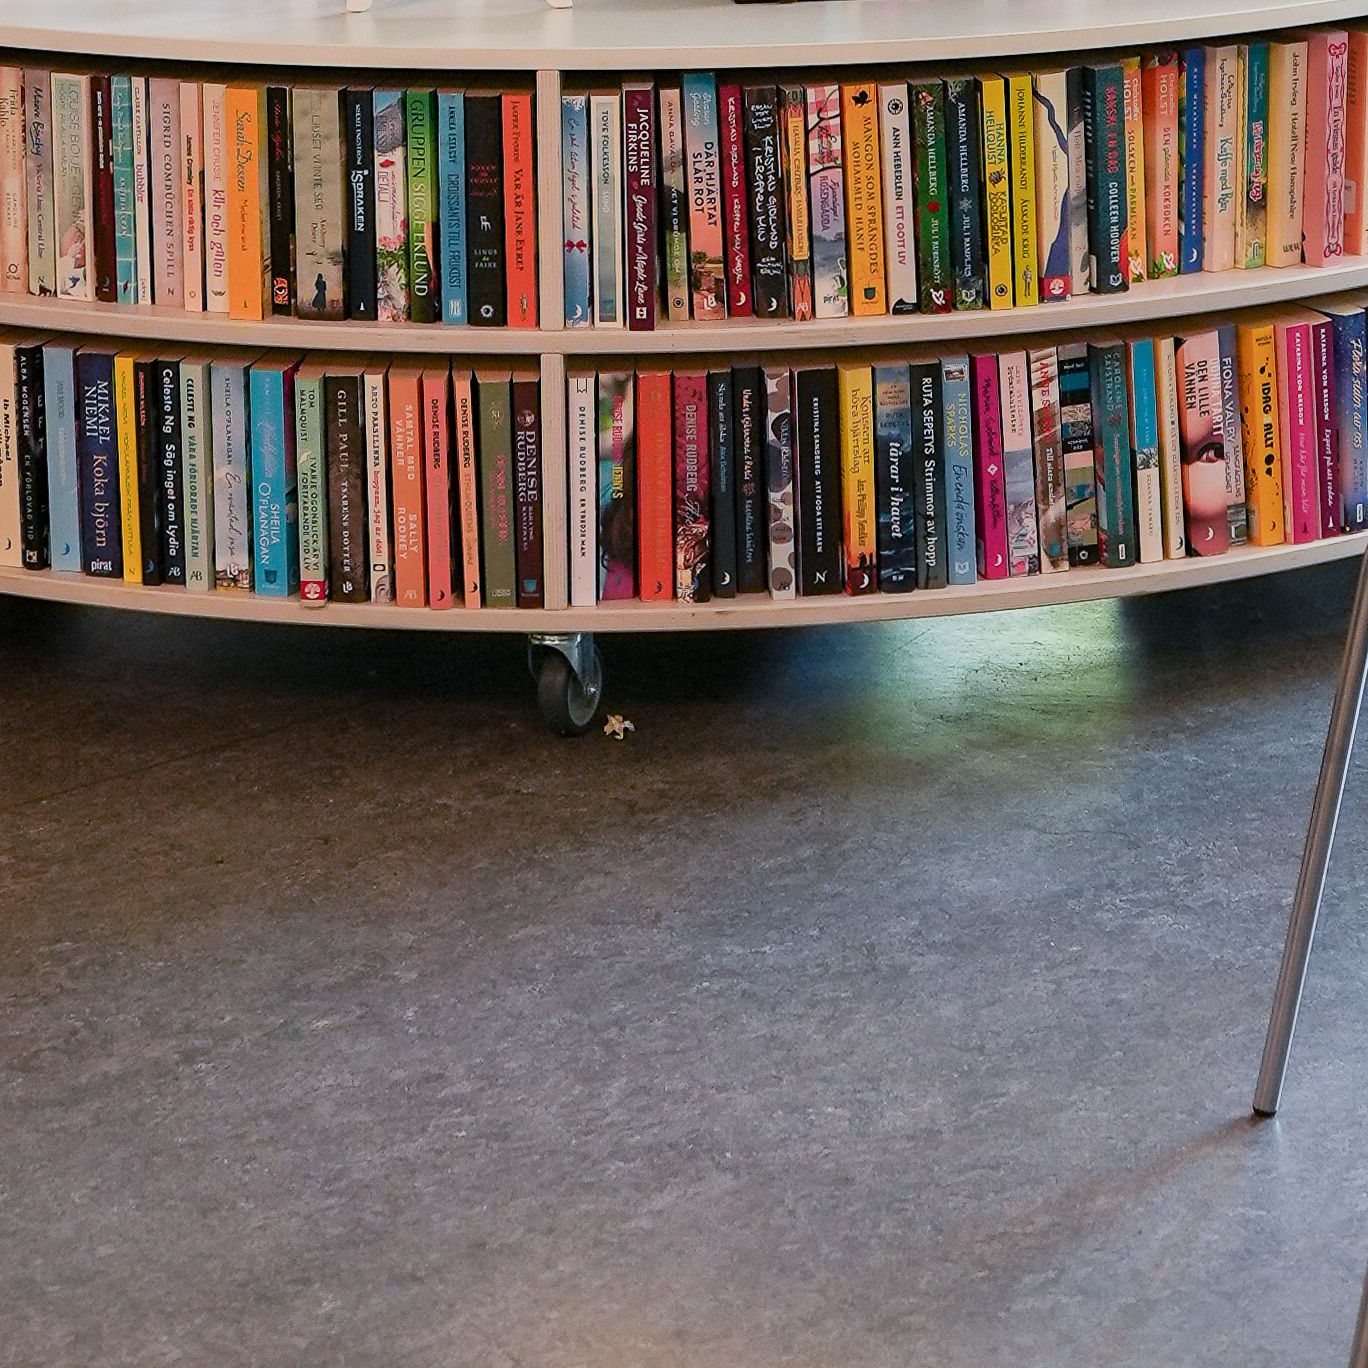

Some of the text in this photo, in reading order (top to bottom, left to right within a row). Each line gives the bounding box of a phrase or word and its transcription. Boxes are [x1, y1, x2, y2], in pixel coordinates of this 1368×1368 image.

[601, 110, 610, 185] TOVE FOLKESSON
[628, 123, 638, 172] FIRKINS
[637, 108, 650, 186] JACQUELINE
[162, 103, 175, 278] SIGRID COMBÜCHEN SPILL
[410, 100, 428, 296] GRUPPEN SIGGE EKLUND
[692, 152, 705, 213] SLÅR ROT
[705, 142, 718, 227] DÄR HJÄRTAT
[1109, 182, 1120, 263] COLLEEN HOOVER
[84, 386, 97, 437] NIEMI
[96, 381, 110, 445] MIKAEL
[308, 389, 316, 408] TOM
[1185, 363, 1198, 410] VÄNNEN
[1196, 360, 1209, 417] DEN LILLE
[1222, 357, 1235, 442] FIONA VALPY
[1261, 382, 1273, 449] IDAG ALLT
[404, 404, 416, 481] SAMTAL MED
[685, 404, 698, 492] DENISE RUDBERG
[957, 392, 969, 458] NICHOLAS
[162, 369, 179, 556] Celeste Ng Säg inget om Lydia
[516, 431, 527, 502] RUDBERG
[526, 431, 538, 501] DENISE
[921, 377, 939, 566] RUTA SEPETYS Strimmor av hopp
[92, 455, 109, 547] Koka björn
[271, 503, 281, 546] SHEILA
[408, 514, 418, 553] SALLY
[91, 557, 113, 572] pirat
